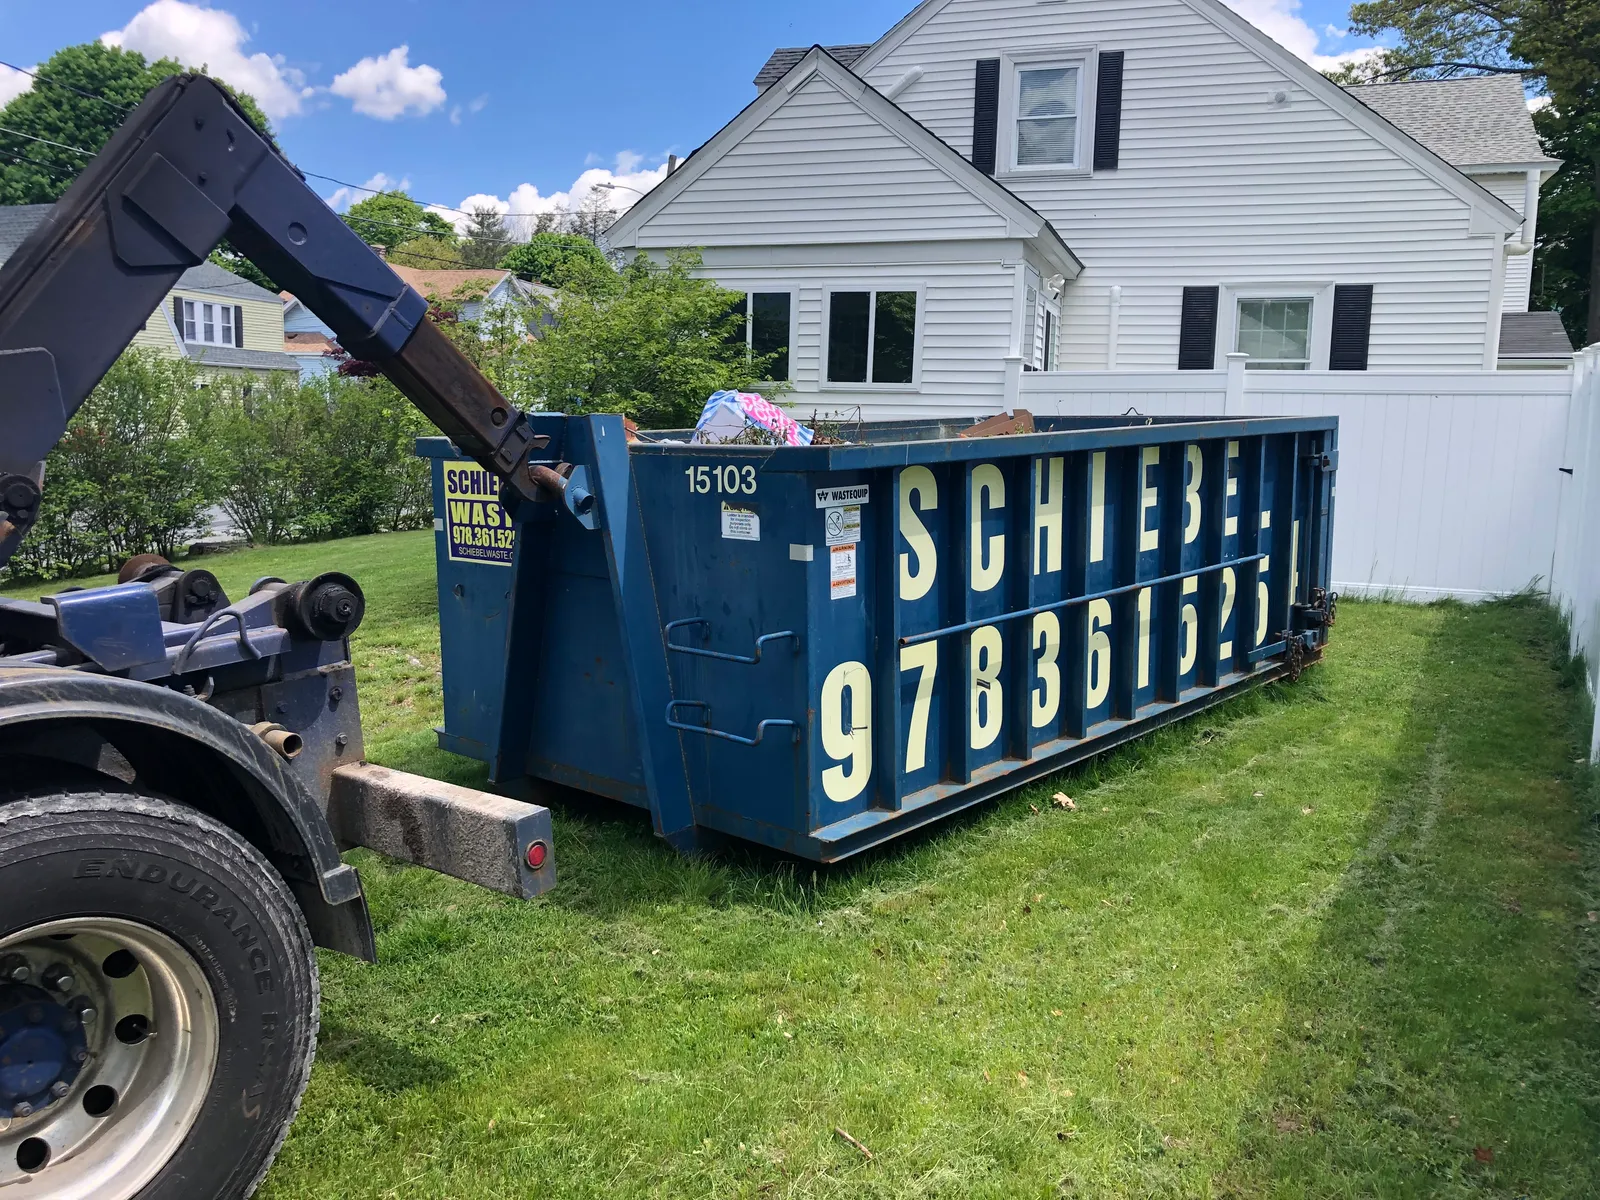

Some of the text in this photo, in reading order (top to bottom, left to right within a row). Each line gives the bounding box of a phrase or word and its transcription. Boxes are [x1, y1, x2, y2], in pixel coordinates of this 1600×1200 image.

[685, 465, 757, 495] 15103
[832, 488, 868, 501] WASTEQUIP
[899, 440, 1271, 601] SCHIEBE
[73, 858, 275, 996] ENDURANCE
